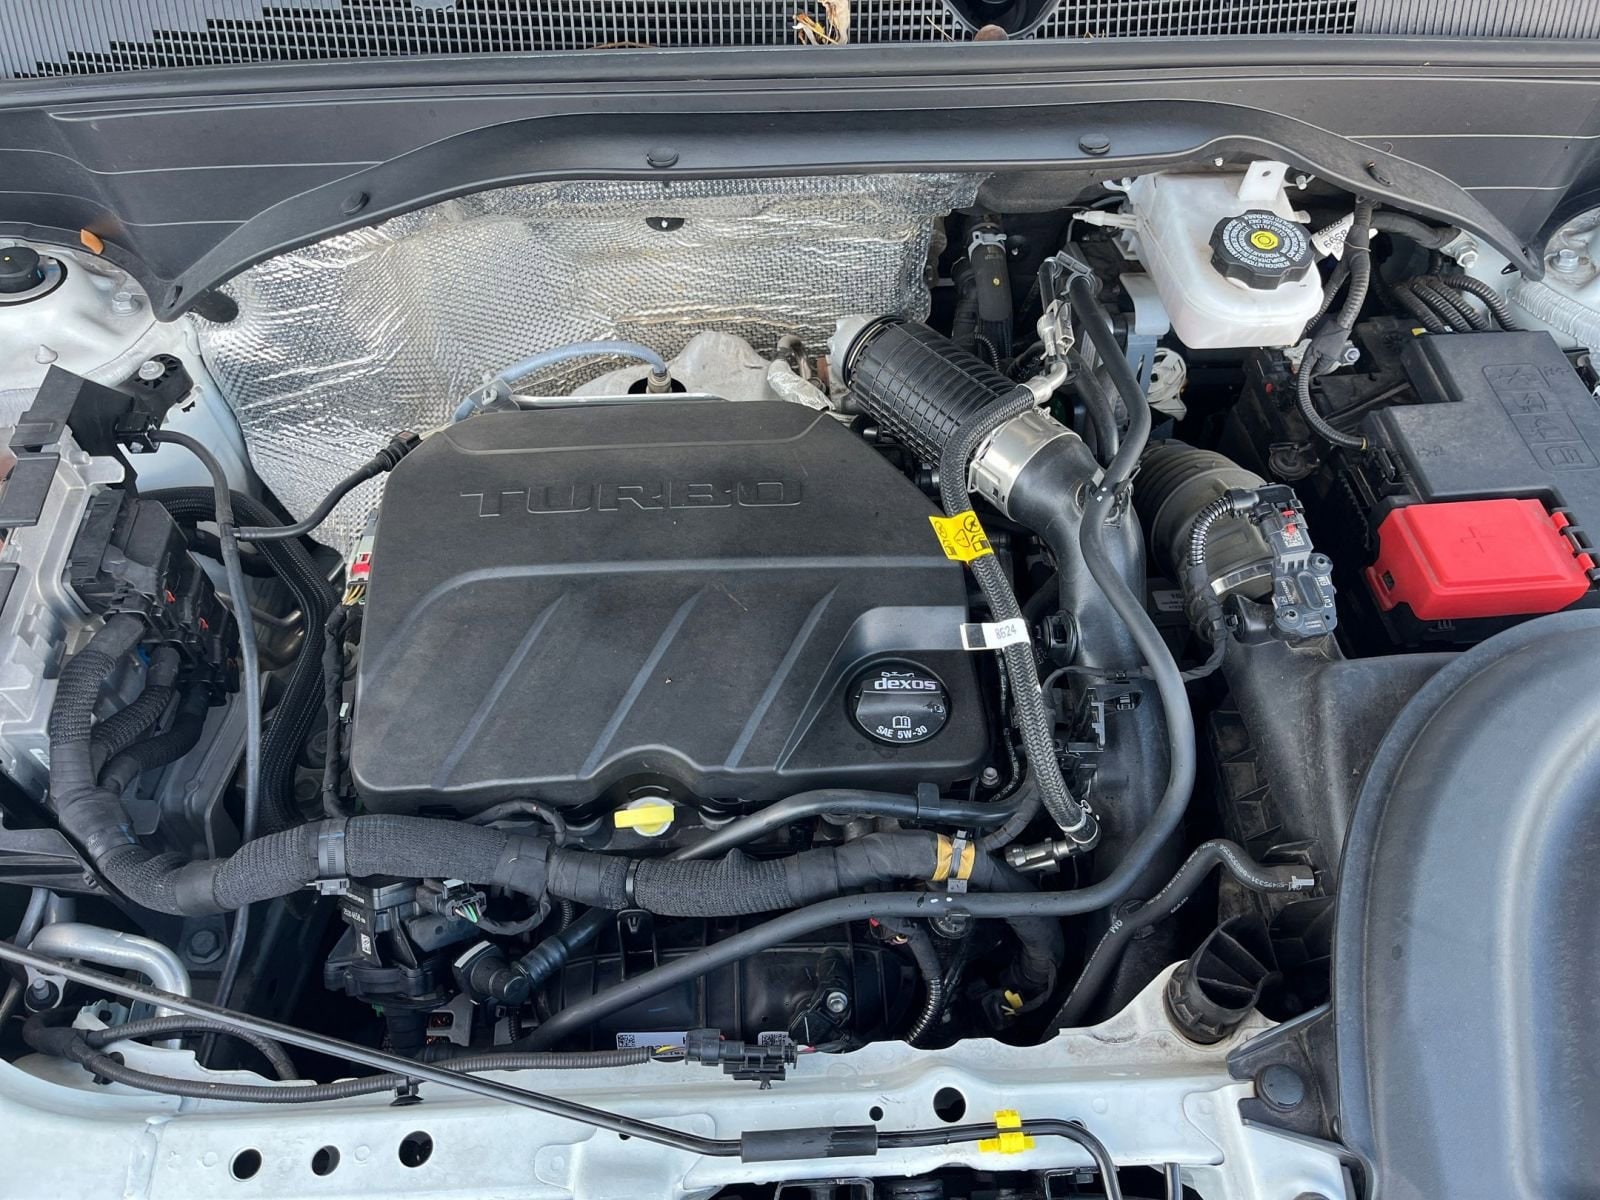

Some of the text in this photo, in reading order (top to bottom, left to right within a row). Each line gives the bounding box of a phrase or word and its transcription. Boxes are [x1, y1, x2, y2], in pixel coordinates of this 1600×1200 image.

[459, 479, 801, 517] TURBO
[874, 677, 938, 690] dexos
[876, 725, 928, 739] SAE 5W-30
